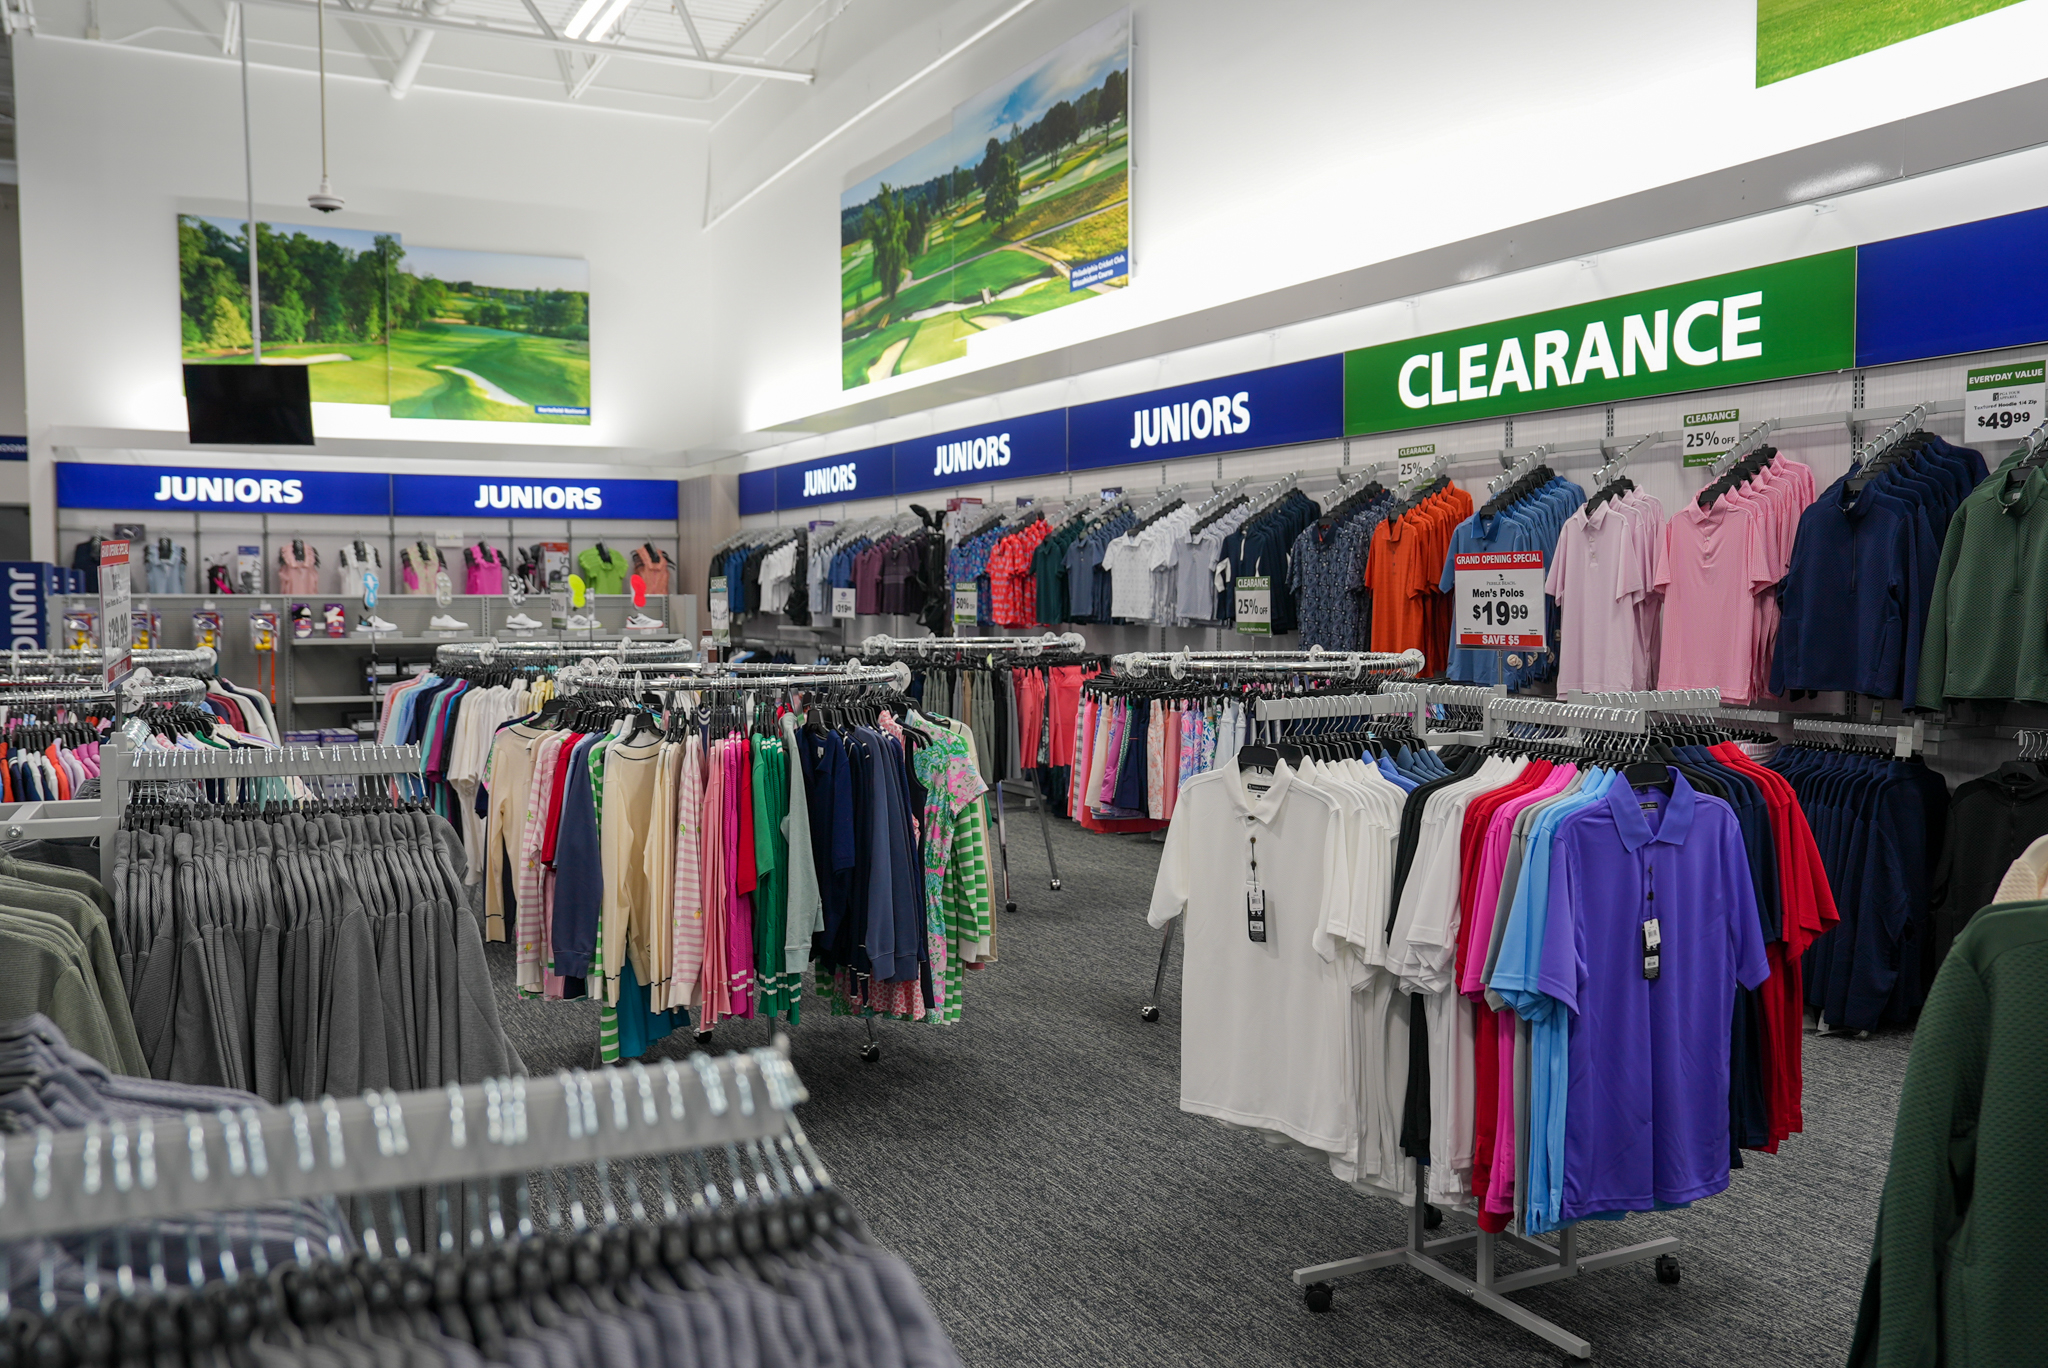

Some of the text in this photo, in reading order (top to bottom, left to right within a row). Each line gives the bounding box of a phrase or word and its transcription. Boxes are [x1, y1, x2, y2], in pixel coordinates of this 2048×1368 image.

[1399, 291, 1763, 409] CLEARANCE
[1969, 368, 2043, 384] EVERYDAY VALUE
[1130, 391, 1251, 448] JUNIORS
[1686, 410, 1736, 424] CLEARANCE
[1686, 431, 1735, 448] 25% OFF
[934, 433, 1011, 476] JUNIORS
[1400, 445, 1433, 456] CLEARANCE
[1401, 462, 1423, 475] 25%
[803, 463, 857, 497] JUNIORS
[154, 476, 304, 504] JUNIORS
[474, 485, 602, 510] JUNIORS
[1456, 553, 1541, 565] GRAND OPENING SPECIAL
[956, 582, 976, 590] CLEARANCE
[1238, 578, 1269, 588] CLEARANCE
[1472, 588, 1524, 598] Men's Polos
[956, 598, 969, 609] 50%
[1238, 598, 1258, 614] 25%
[1482, 635, 1520, 646] SAVE $5
